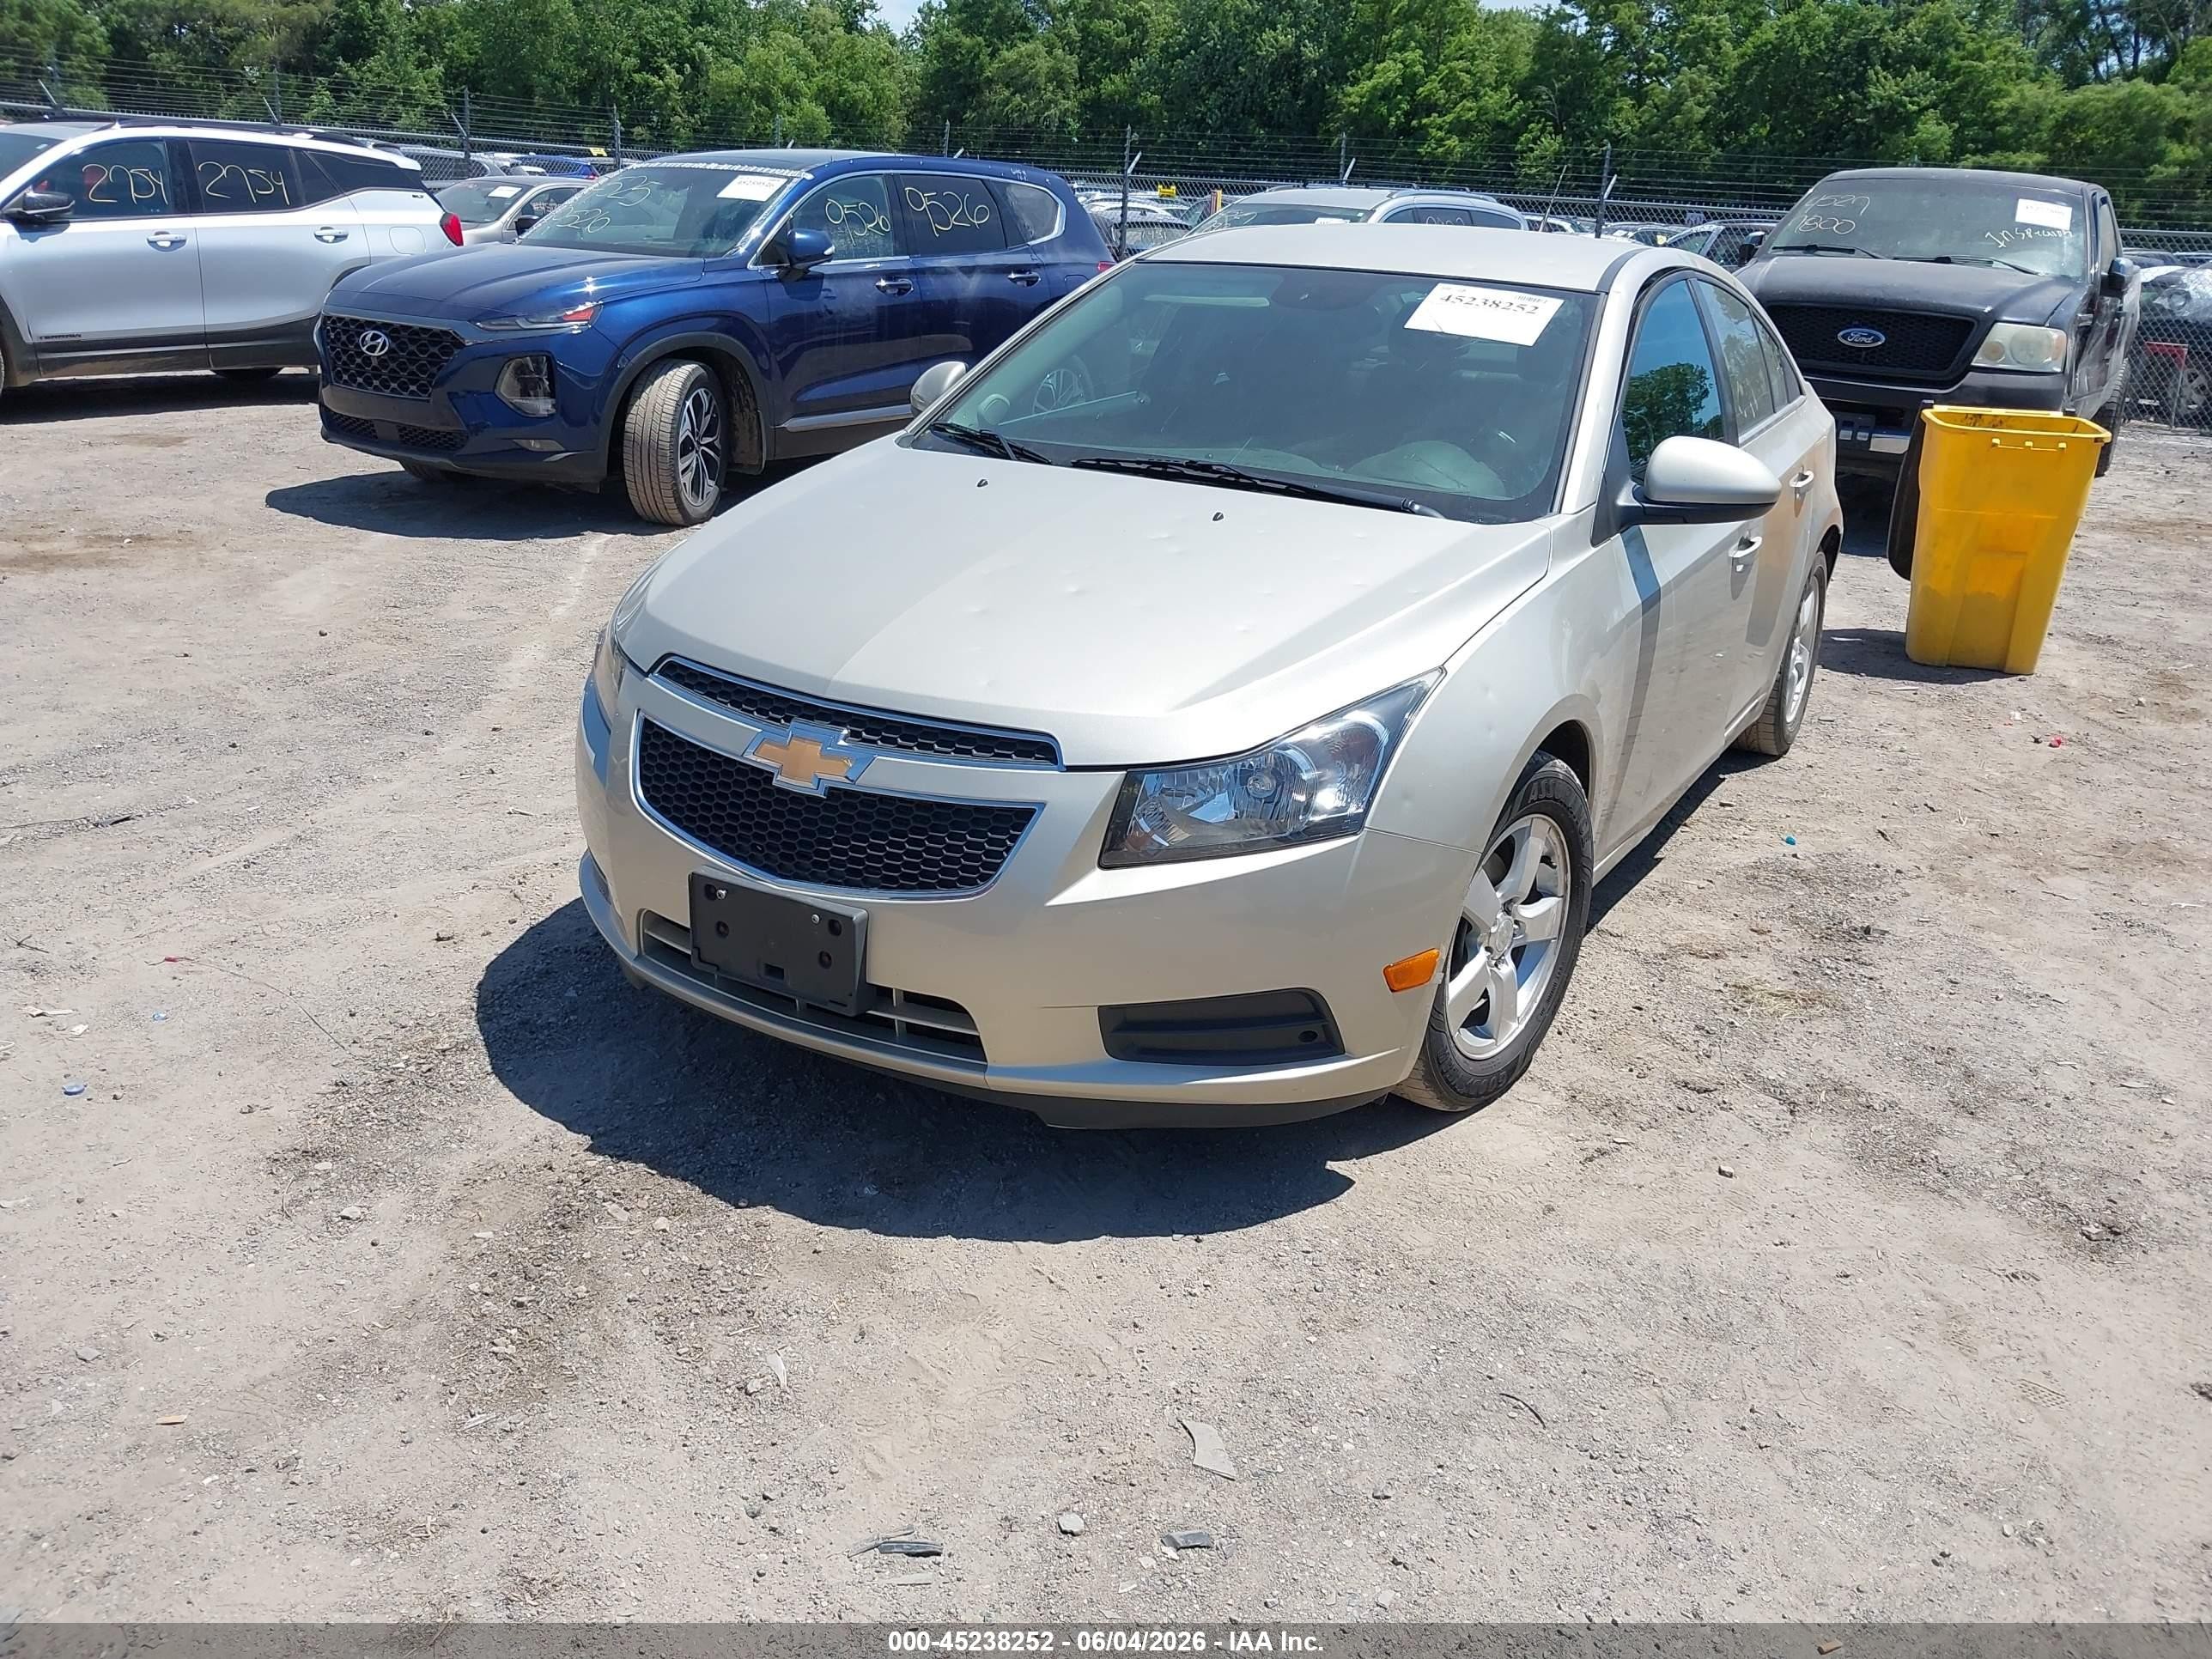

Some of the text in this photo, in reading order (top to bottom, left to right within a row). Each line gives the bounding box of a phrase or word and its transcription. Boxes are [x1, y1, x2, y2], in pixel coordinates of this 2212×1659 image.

[82, 163, 168, 205] 2754
[198, 161, 291, 206] 2754
[825, 198, 890, 247] 9526
[904, 187, 990, 238] 9526
[1440, 295, 1540, 314] 45238252
[1847, 331, 1875, 343] Ford
